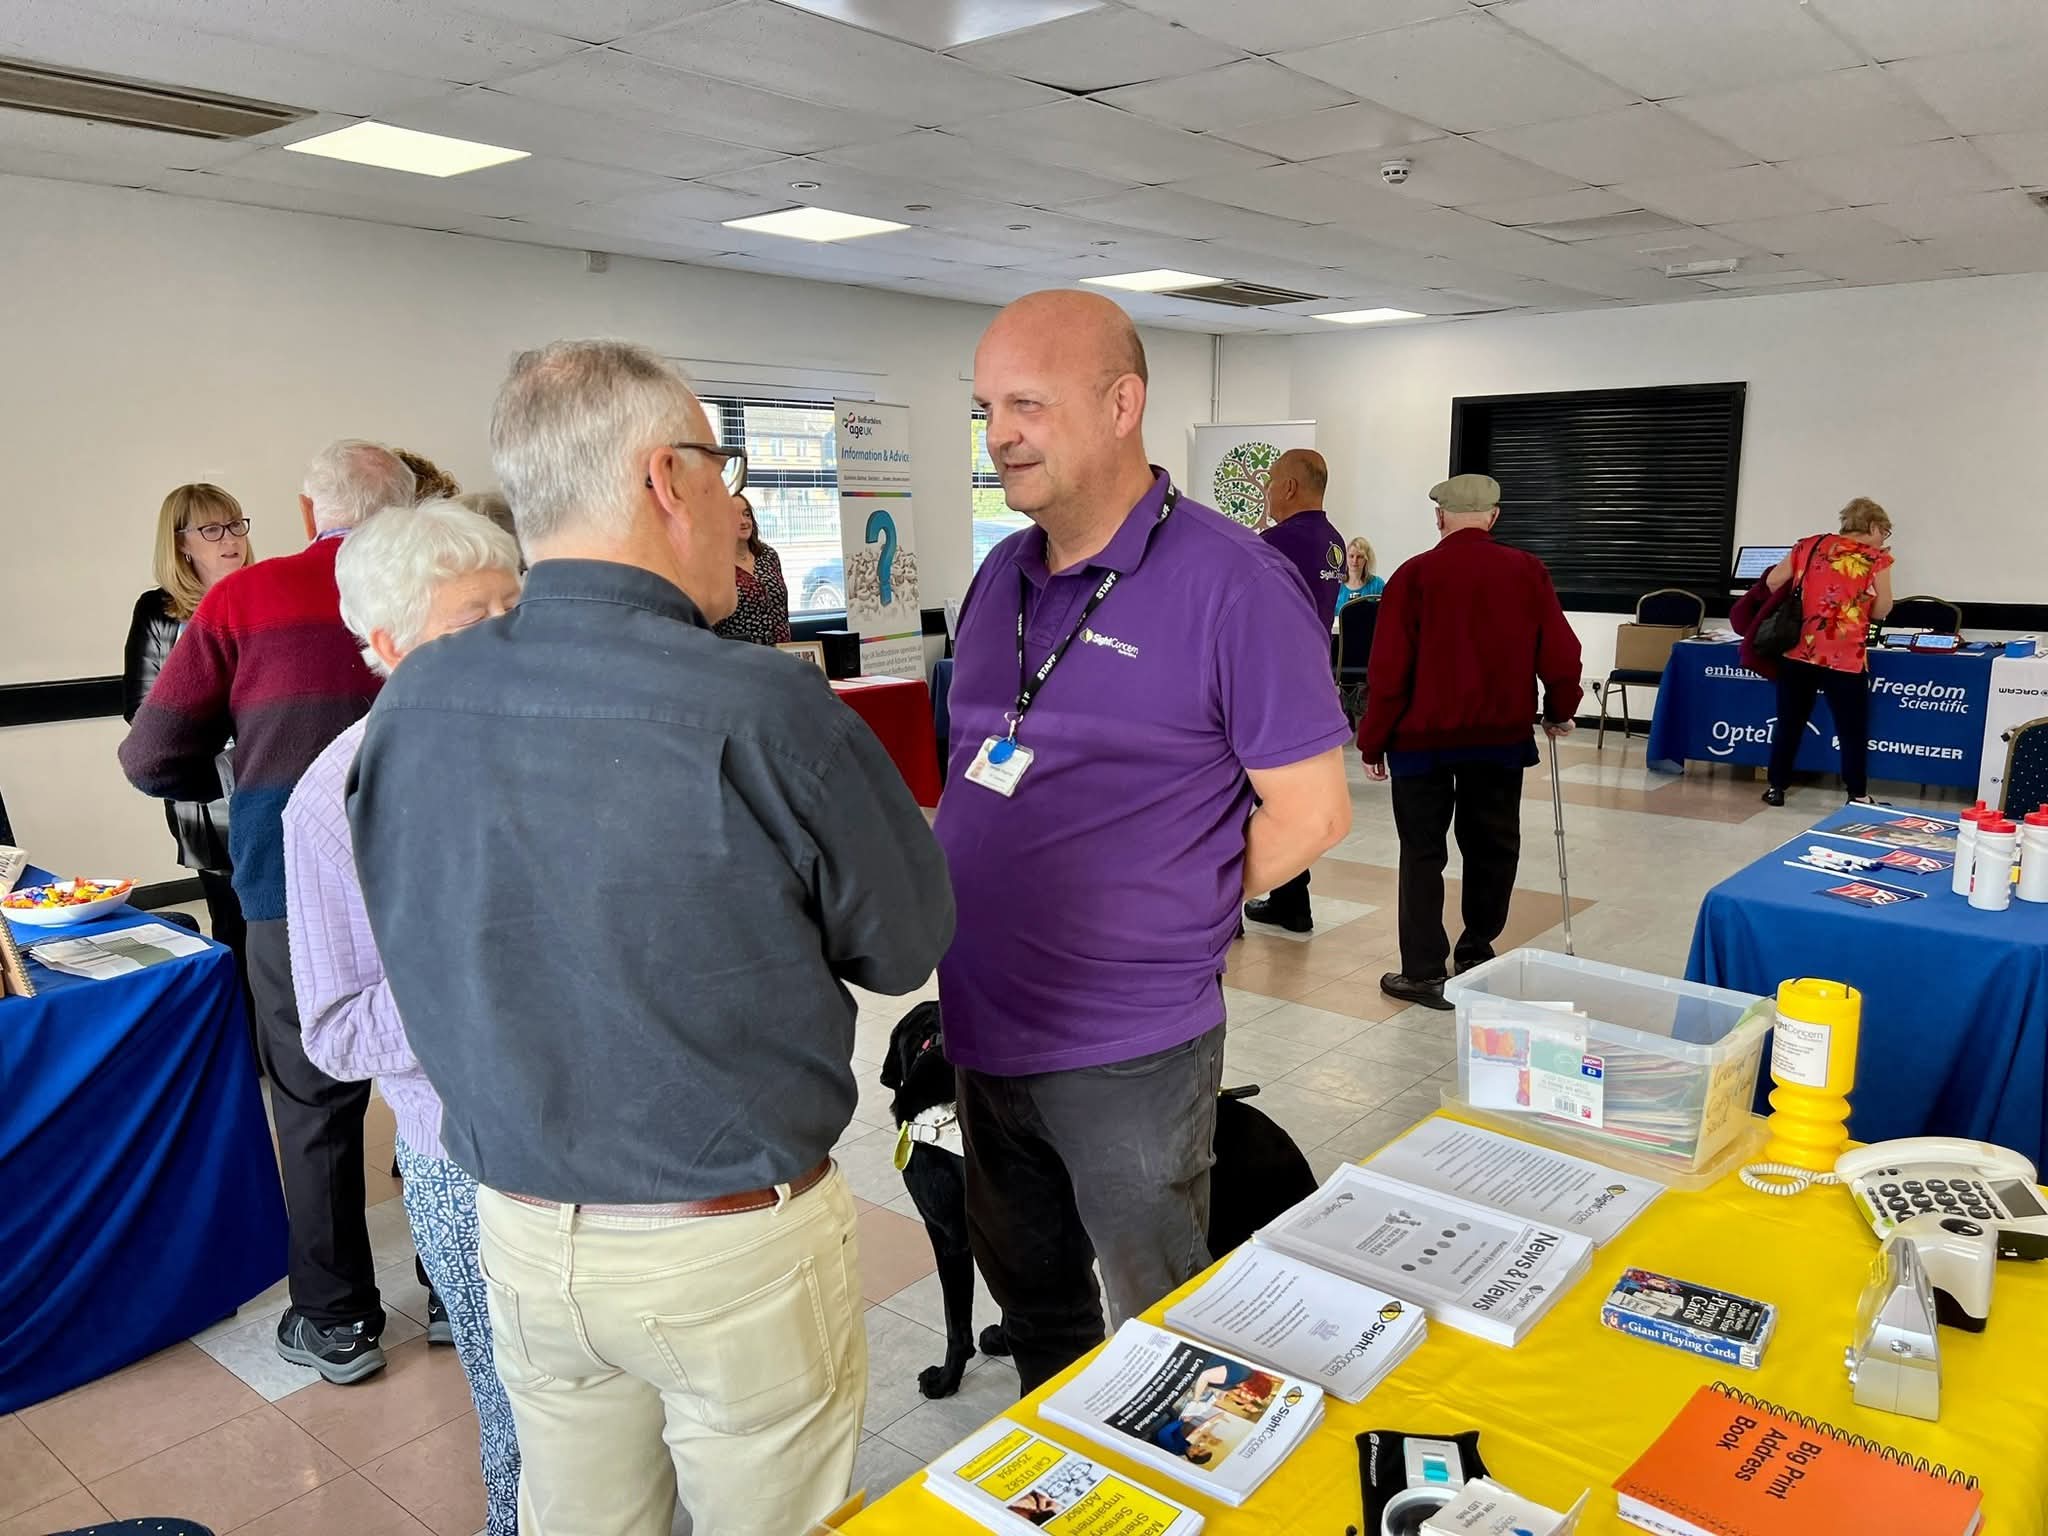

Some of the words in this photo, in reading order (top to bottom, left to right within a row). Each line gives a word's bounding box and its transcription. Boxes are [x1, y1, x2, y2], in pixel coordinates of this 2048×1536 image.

[841, 446, 882, 461] Information
[883, 449, 888, 461] &
[889, 449, 911, 463] Advice
[1096, 571, 1118, 599] STAFF
[1092, 633, 1139, 655] SightConcern
[1037, 653, 1057, 680] STAFF
[1704, 665, 1763, 679] enhan
[1871, 677, 1966, 700] Freedom
[1899, 697, 1969, 714] Scientific
[1712, 721, 1774, 746] Optel
[1867, 739, 1964, 760] SCHWEIZER
[1512, 1231, 1559, 1271] News
[1503, 1266, 1529, 1282] &
[1469, 1275, 1522, 1314] Views
[1681, 1295, 1709, 1321] Cards
[1692, 1294, 1729, 1328] Playing
[1324, 1321, 1387, 1379] SightConcern
[1628, 1321, 1660, 1339] Giant
[1662, 1330, 1703, 1352] Playing
[1704, 1344, 1737, 1361] Cards
[1188, 1358, 1204, 1372] Low
[1172, 1371, 1194, 1391] Vision
[1153, 1389, 1179, 1413] Services
[1240, 1406, 1291, 1459] SightConcern
[1714, 1414, 1758, 1452] Book
[1030, 1455, 1053, 1471] Call
[1732, 1427, 1790, 1484] Address
[1783, 1438, 1823, 1468] Big
[1763, 1464, 1805, 1501] Print
[1065, 1492, 1101, 1522] Advisor
[1069, 1492, 1126, 1536] Impairment
[1141, 1520, 1164, 1536] Ma
